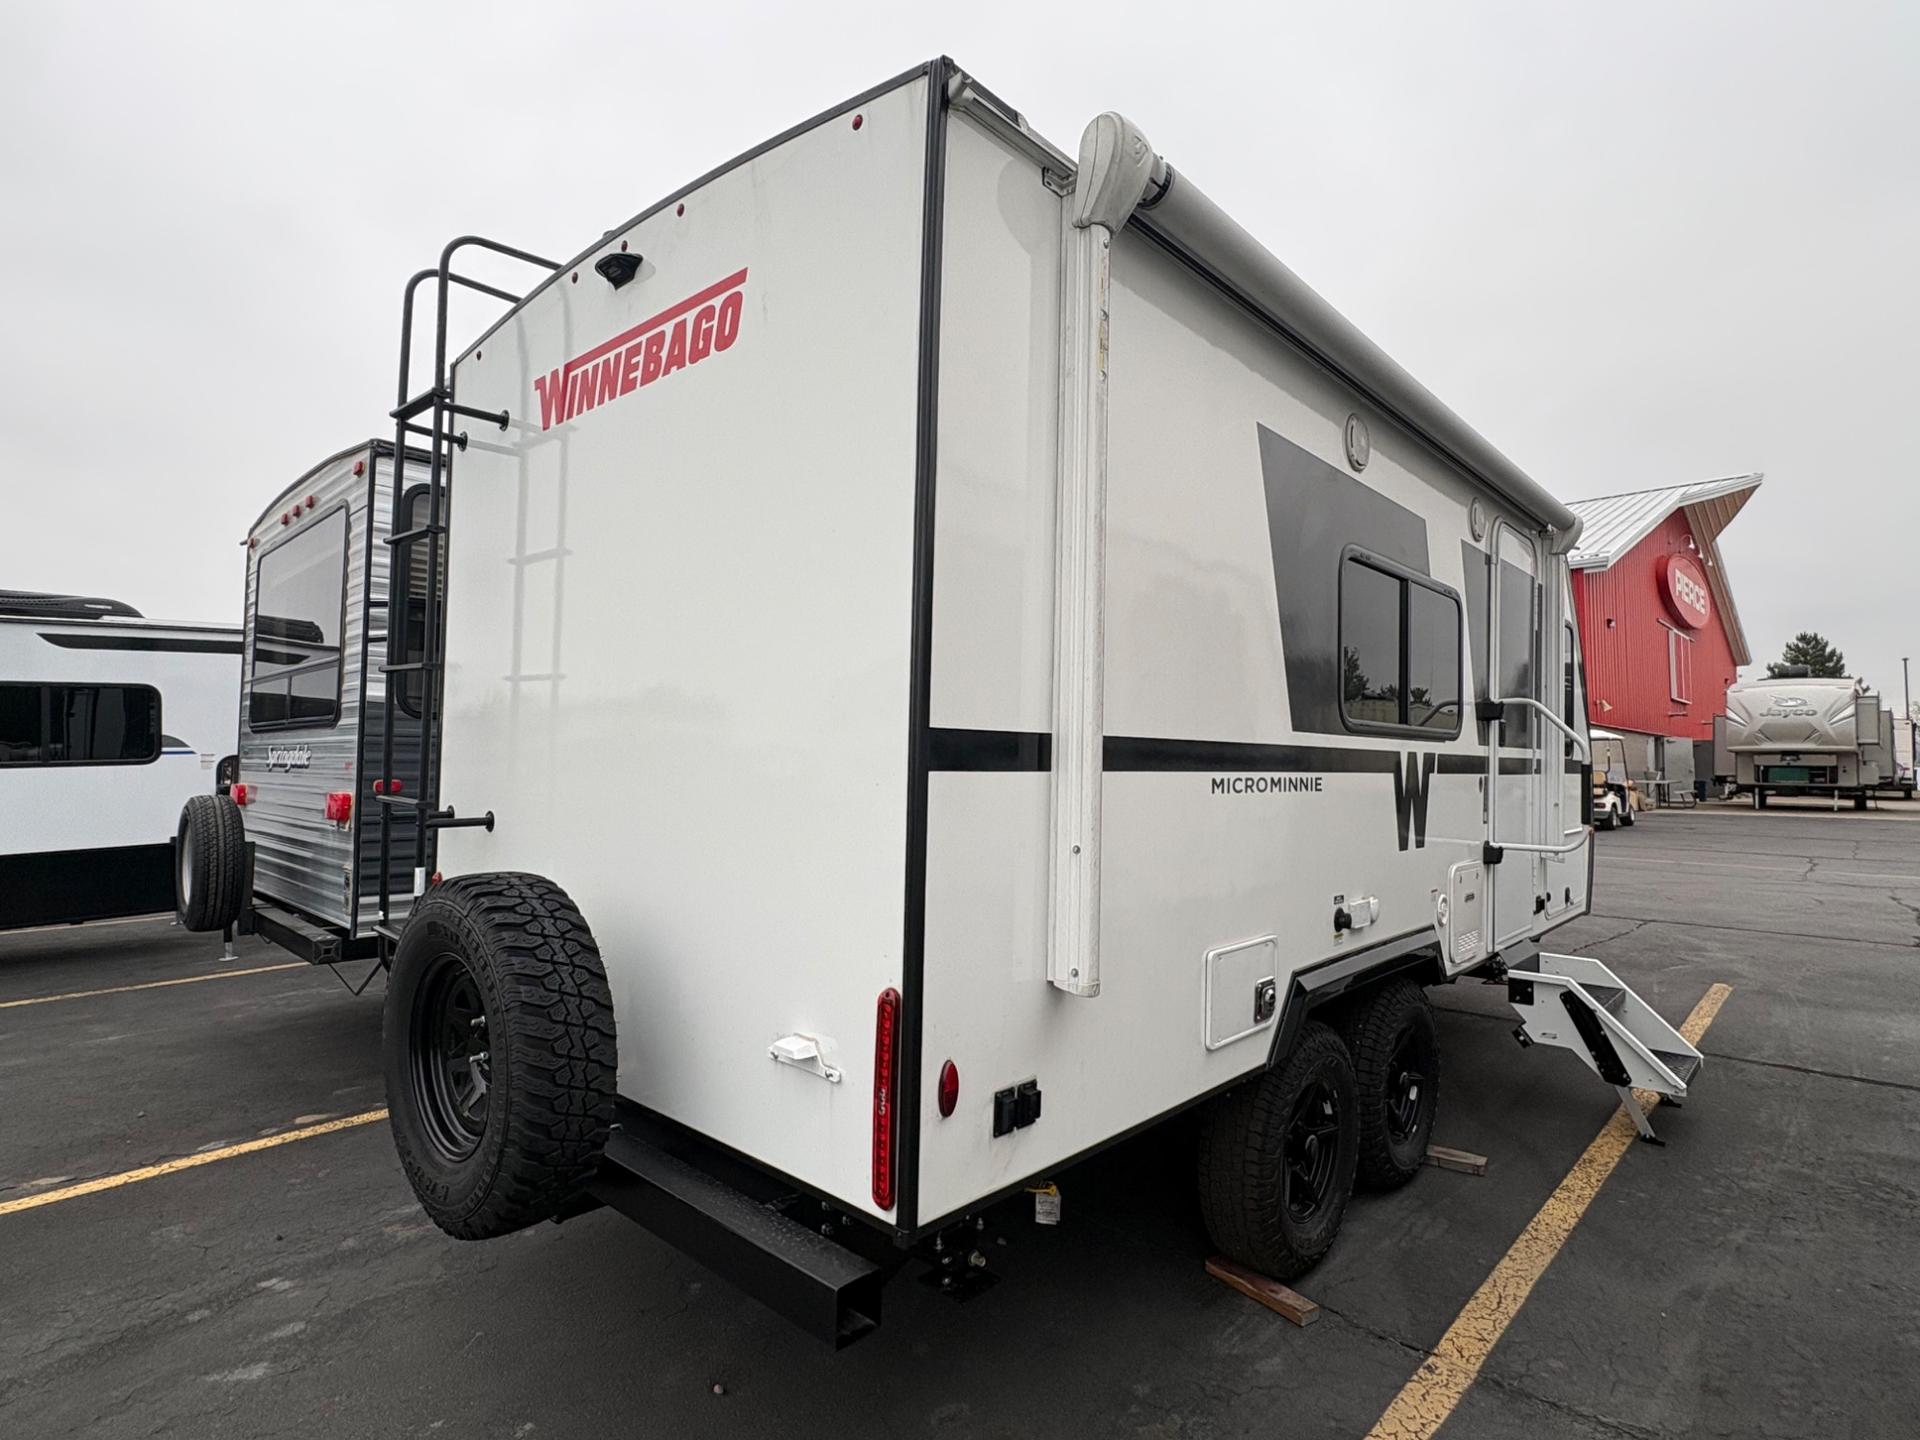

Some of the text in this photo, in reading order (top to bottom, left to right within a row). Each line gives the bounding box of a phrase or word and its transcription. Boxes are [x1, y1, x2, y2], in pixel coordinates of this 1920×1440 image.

[534, 268, 747, 431] WINNEBAGO
[1759, 707, 1817, 718] Jayco
[266, 744, 311, 770] Springdale
